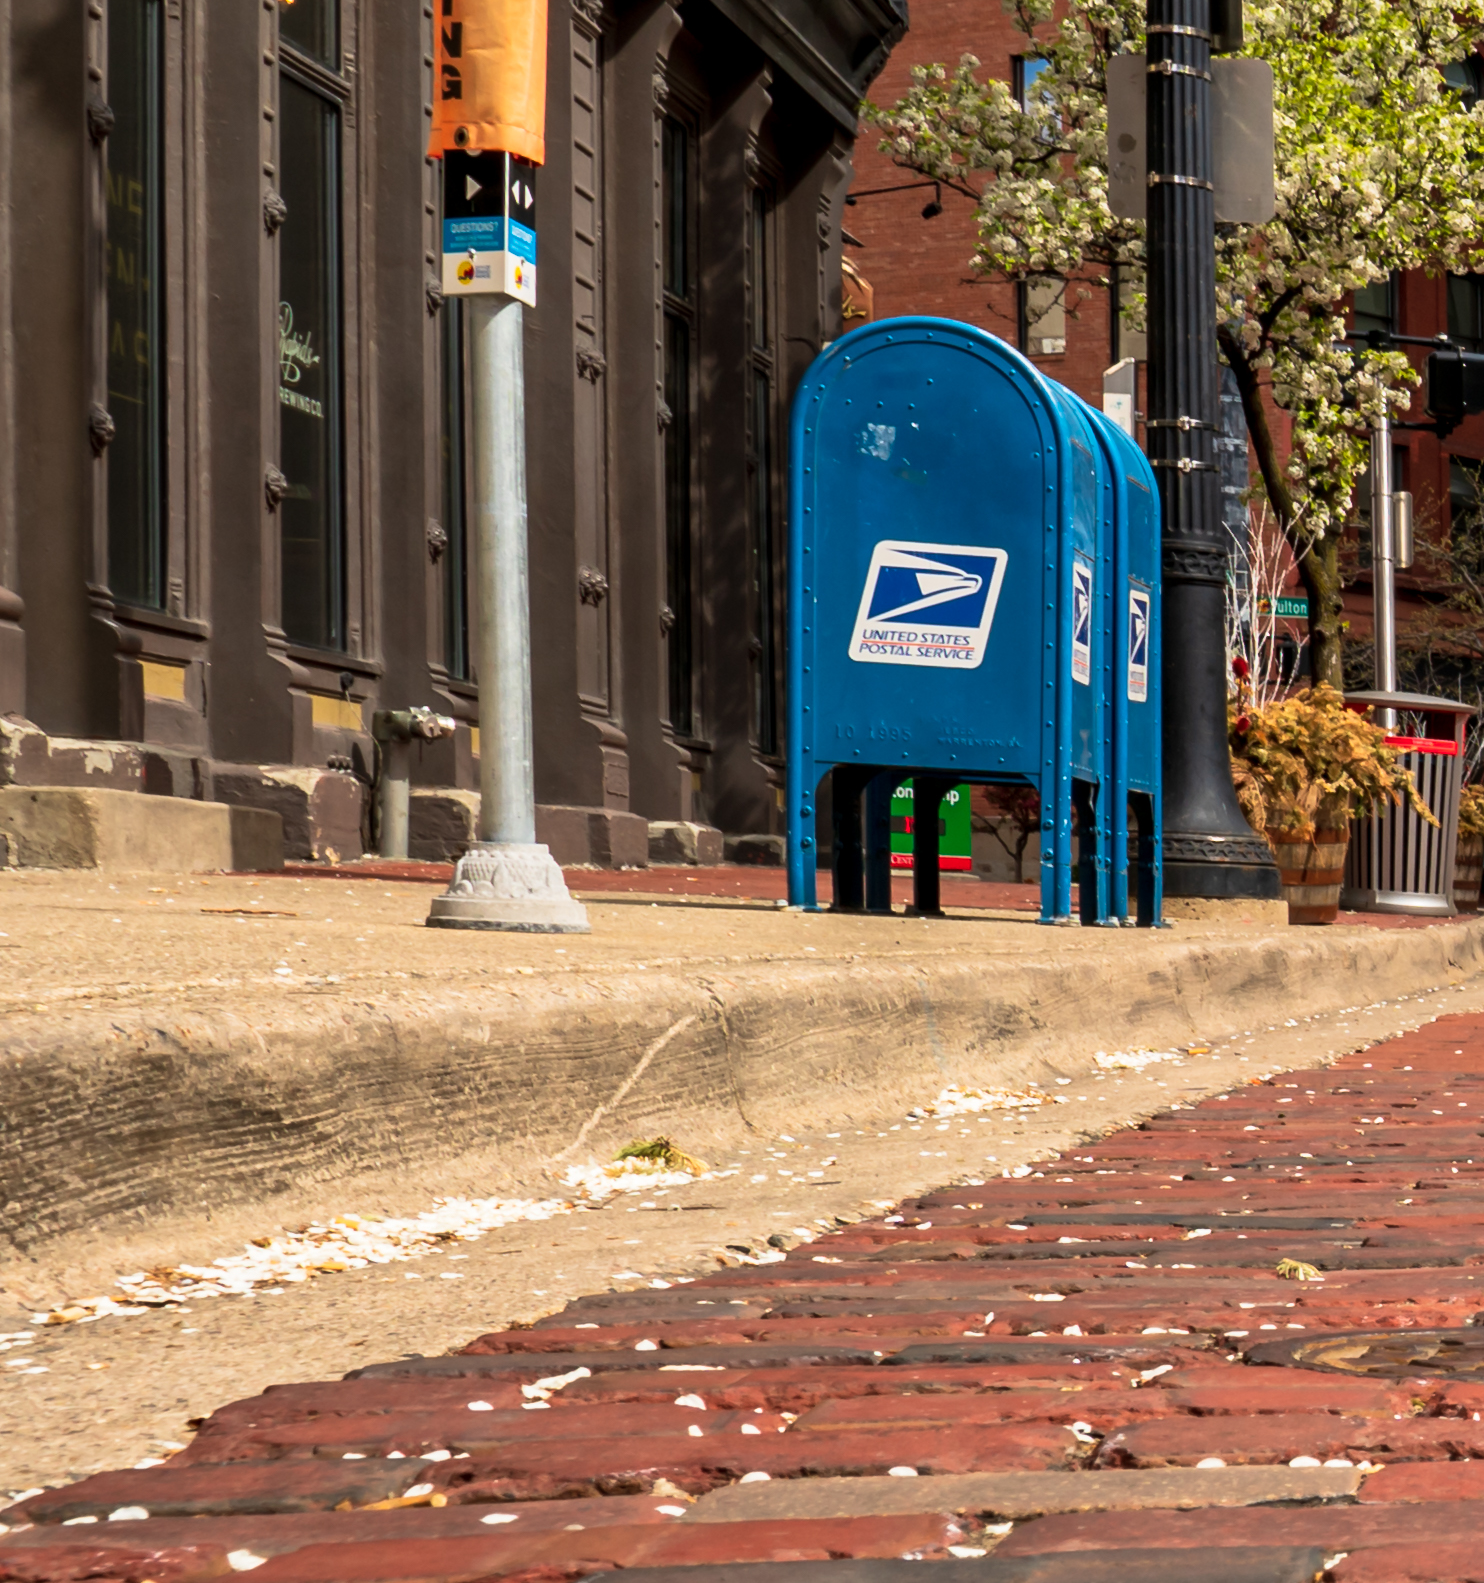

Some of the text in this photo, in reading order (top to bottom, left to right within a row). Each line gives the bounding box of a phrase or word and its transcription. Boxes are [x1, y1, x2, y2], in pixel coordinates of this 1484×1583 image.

[279, 386, 311, 413] REWING
[862, 629, 971, 646] UNITED STATES
[859, 643, 973, 660] POSTAL SERVICE
